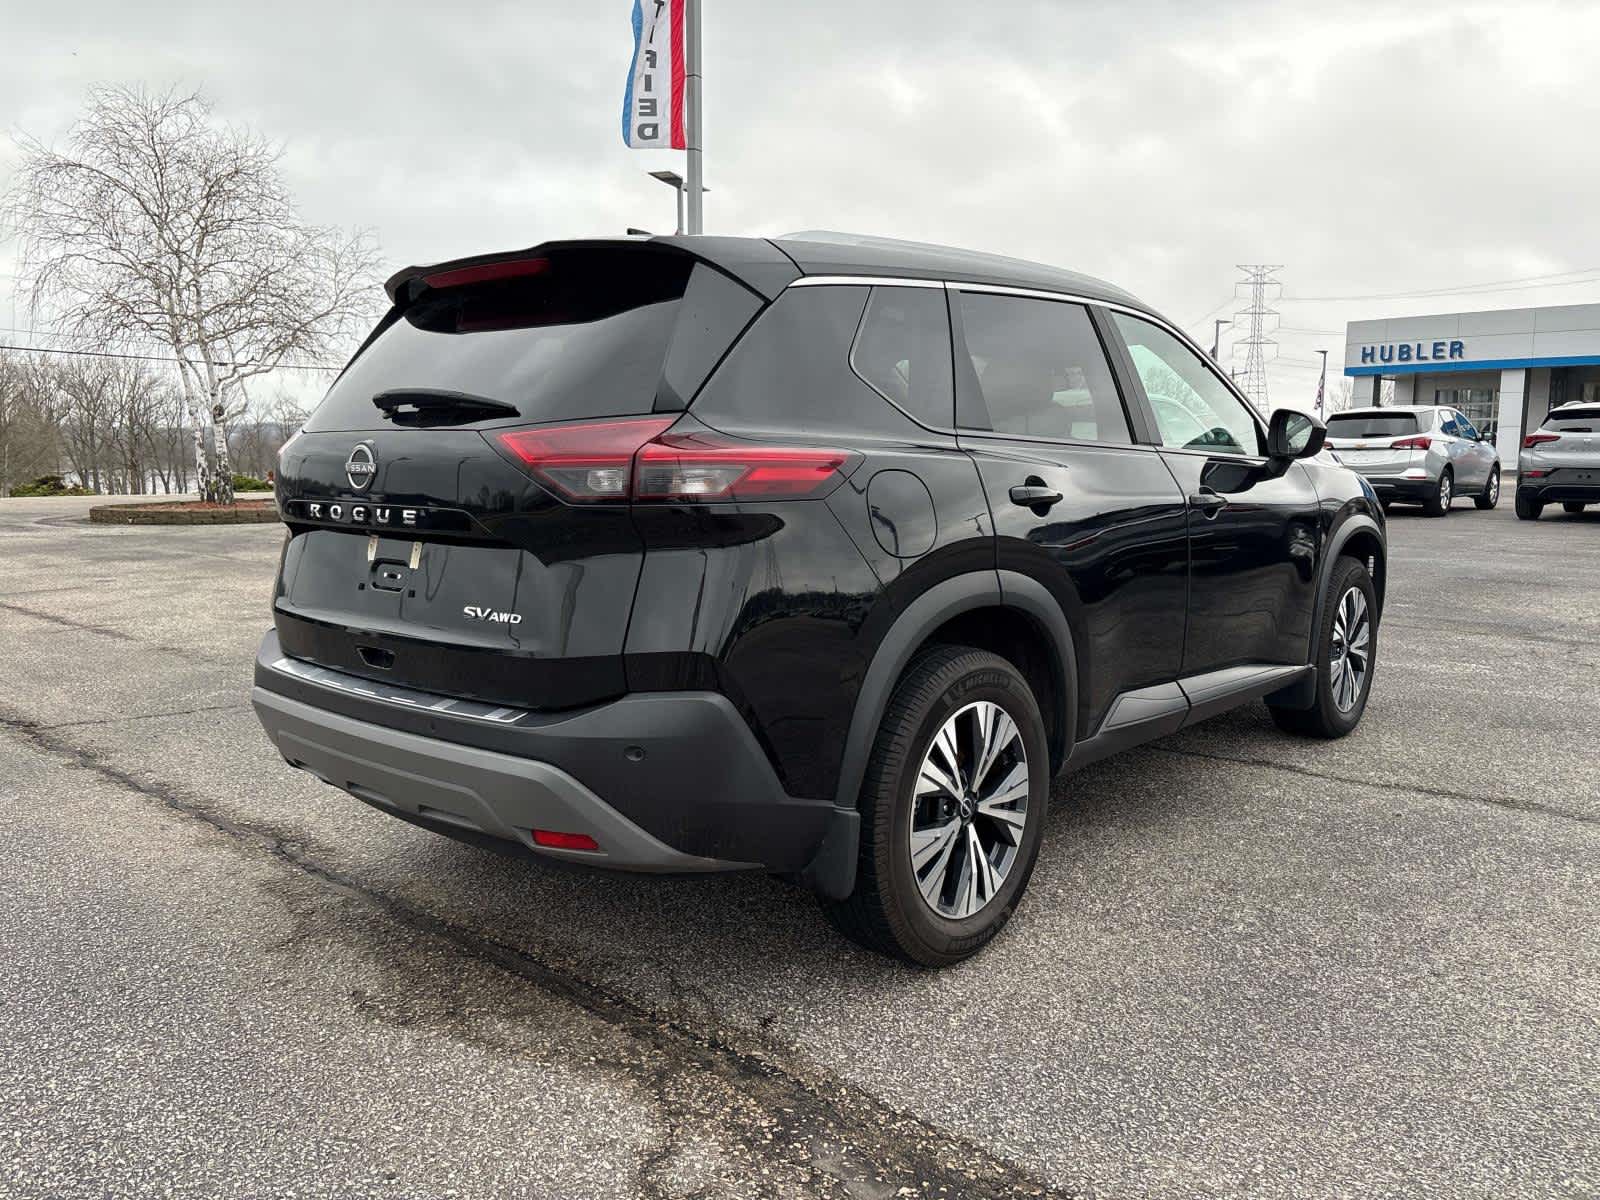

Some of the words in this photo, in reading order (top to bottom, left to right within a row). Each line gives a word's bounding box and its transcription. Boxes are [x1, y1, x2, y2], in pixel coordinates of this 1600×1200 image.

[1361, 340, 1464, 364] HUBLER
[345, 463, 376, 473] SSAN
[309, 503, 417, 524] ROGUE
